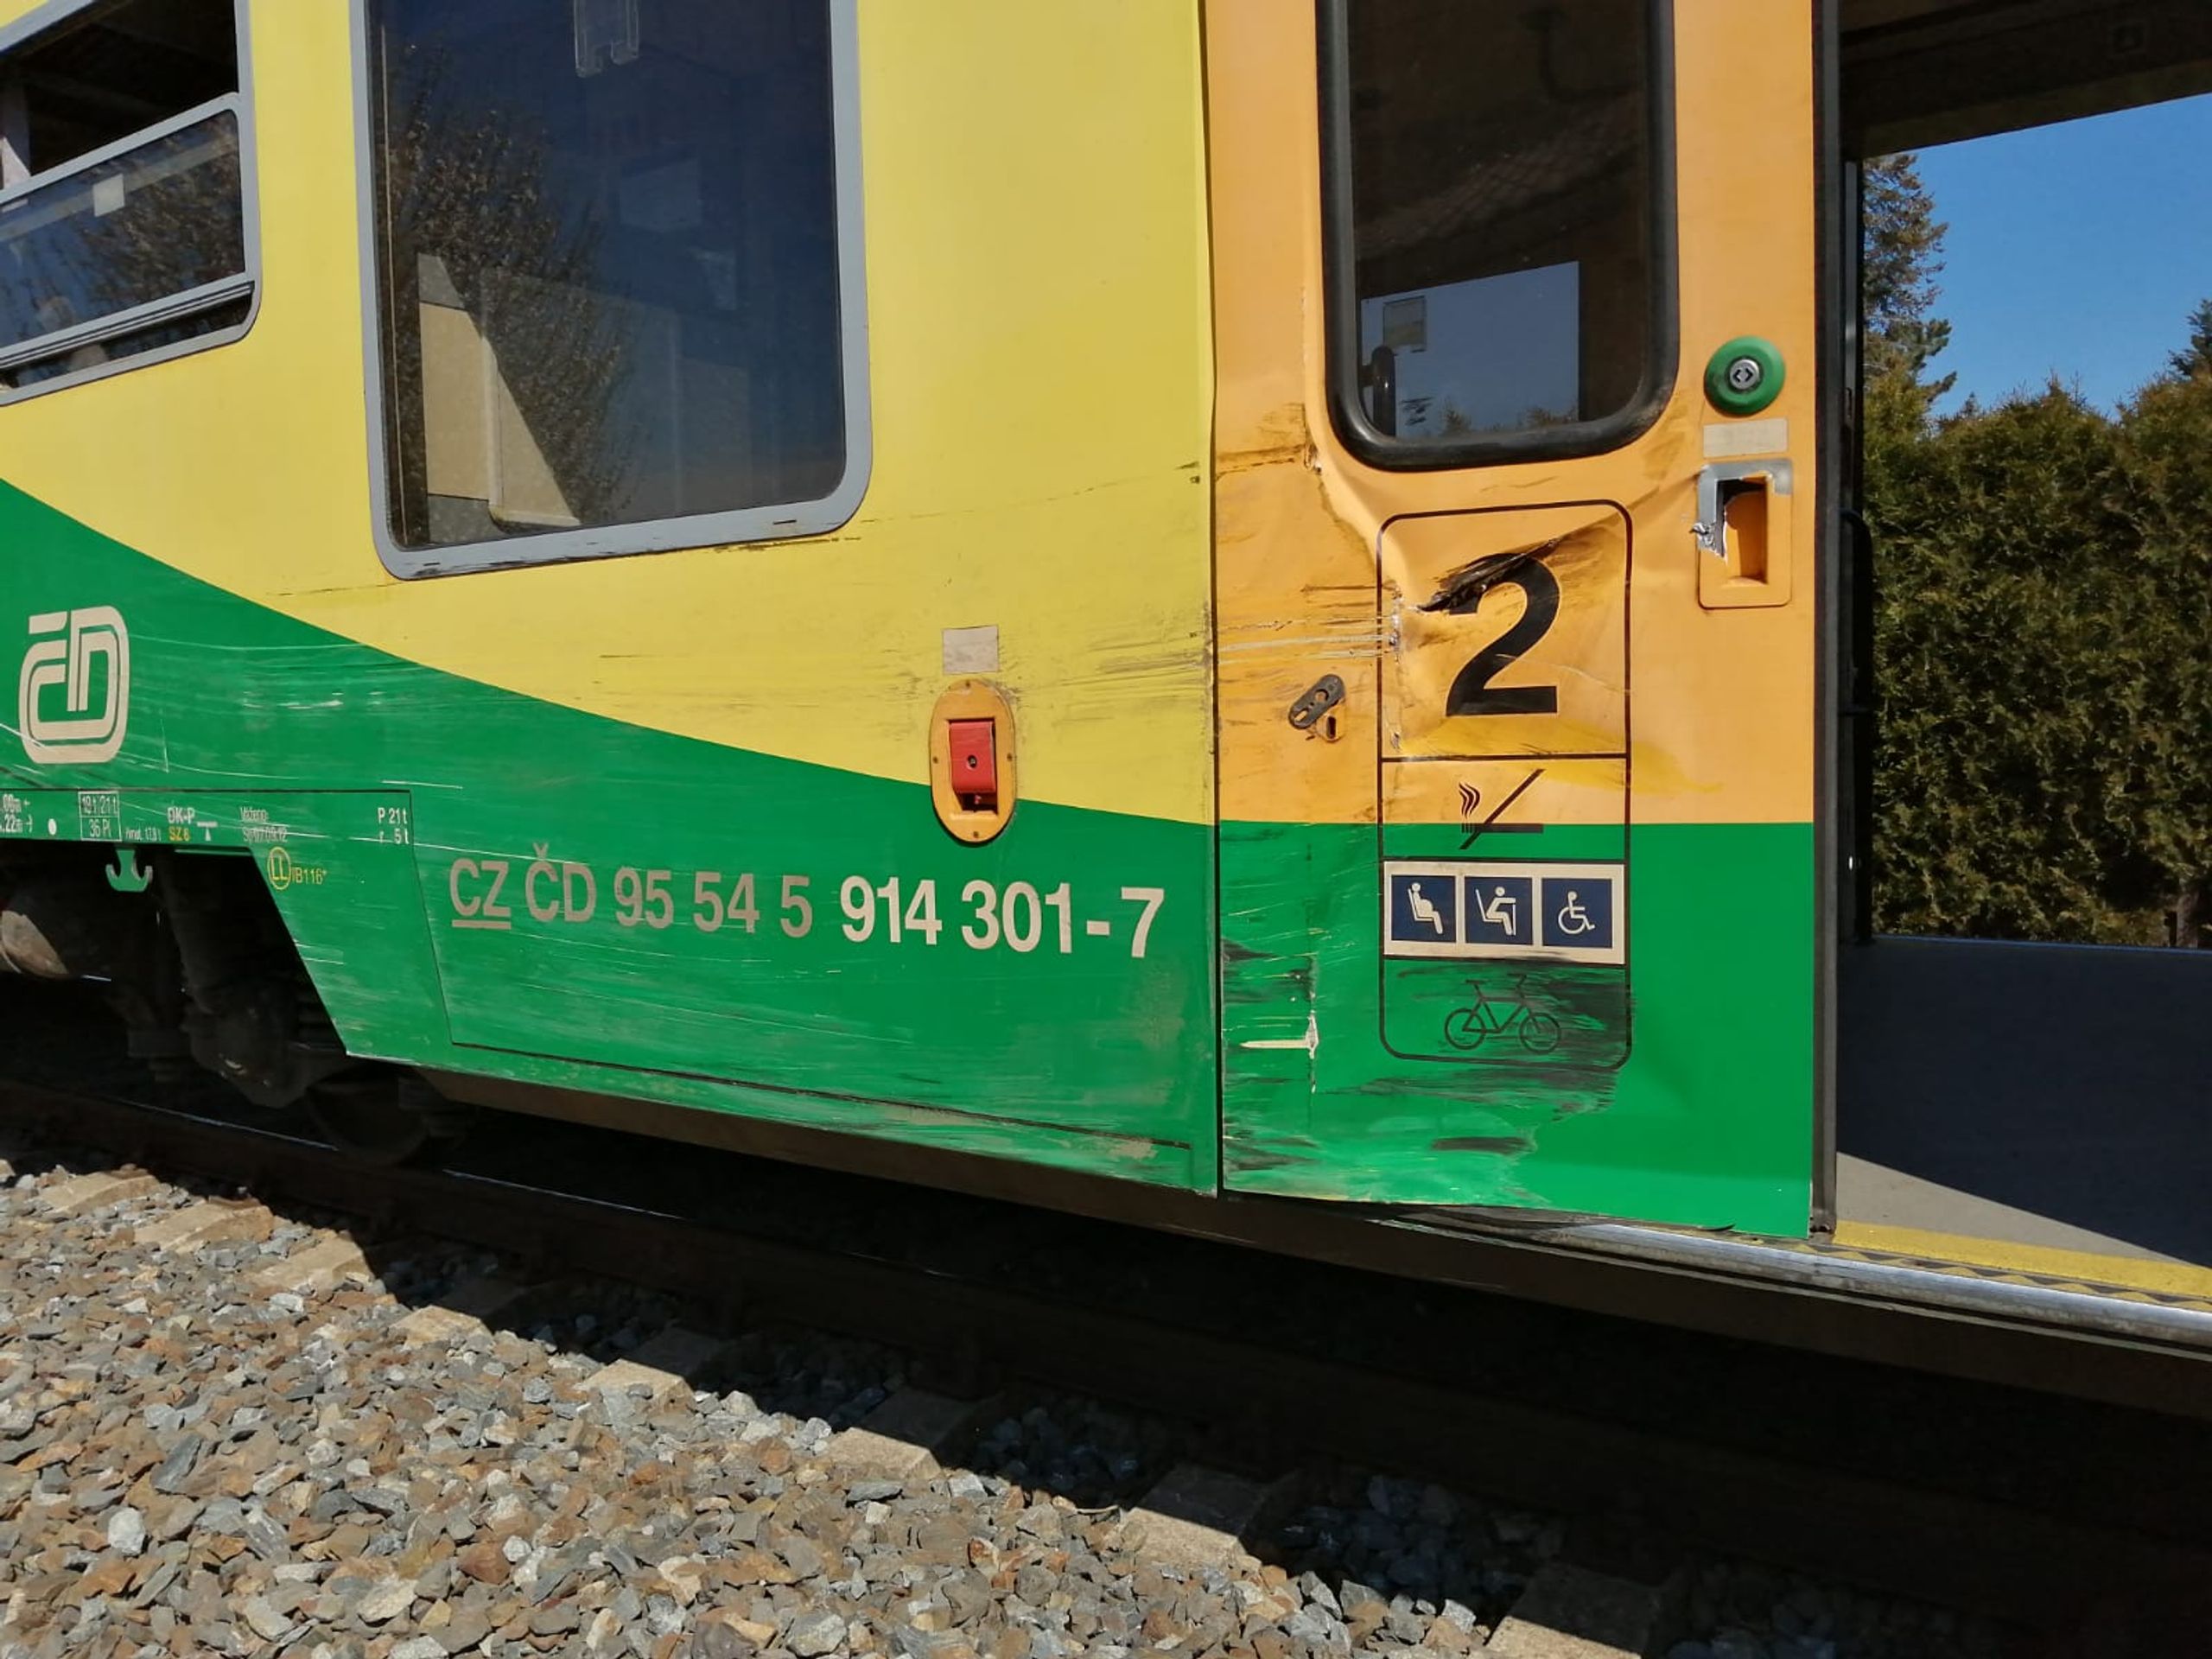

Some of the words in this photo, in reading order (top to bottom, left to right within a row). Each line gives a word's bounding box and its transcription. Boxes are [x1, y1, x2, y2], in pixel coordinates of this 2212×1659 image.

[1446, 552, 1561, 717] 2
[449, 857, 512, 918] CZ
[524, 842, 597, 923] ČD
[613, 867, 675, 930] 95
[693, 871, 760, 934] 54
[780, 875, 813, 939] 5
[840, 875, 943, 946] 914
[961, 879, 1166, 959] 301-7
